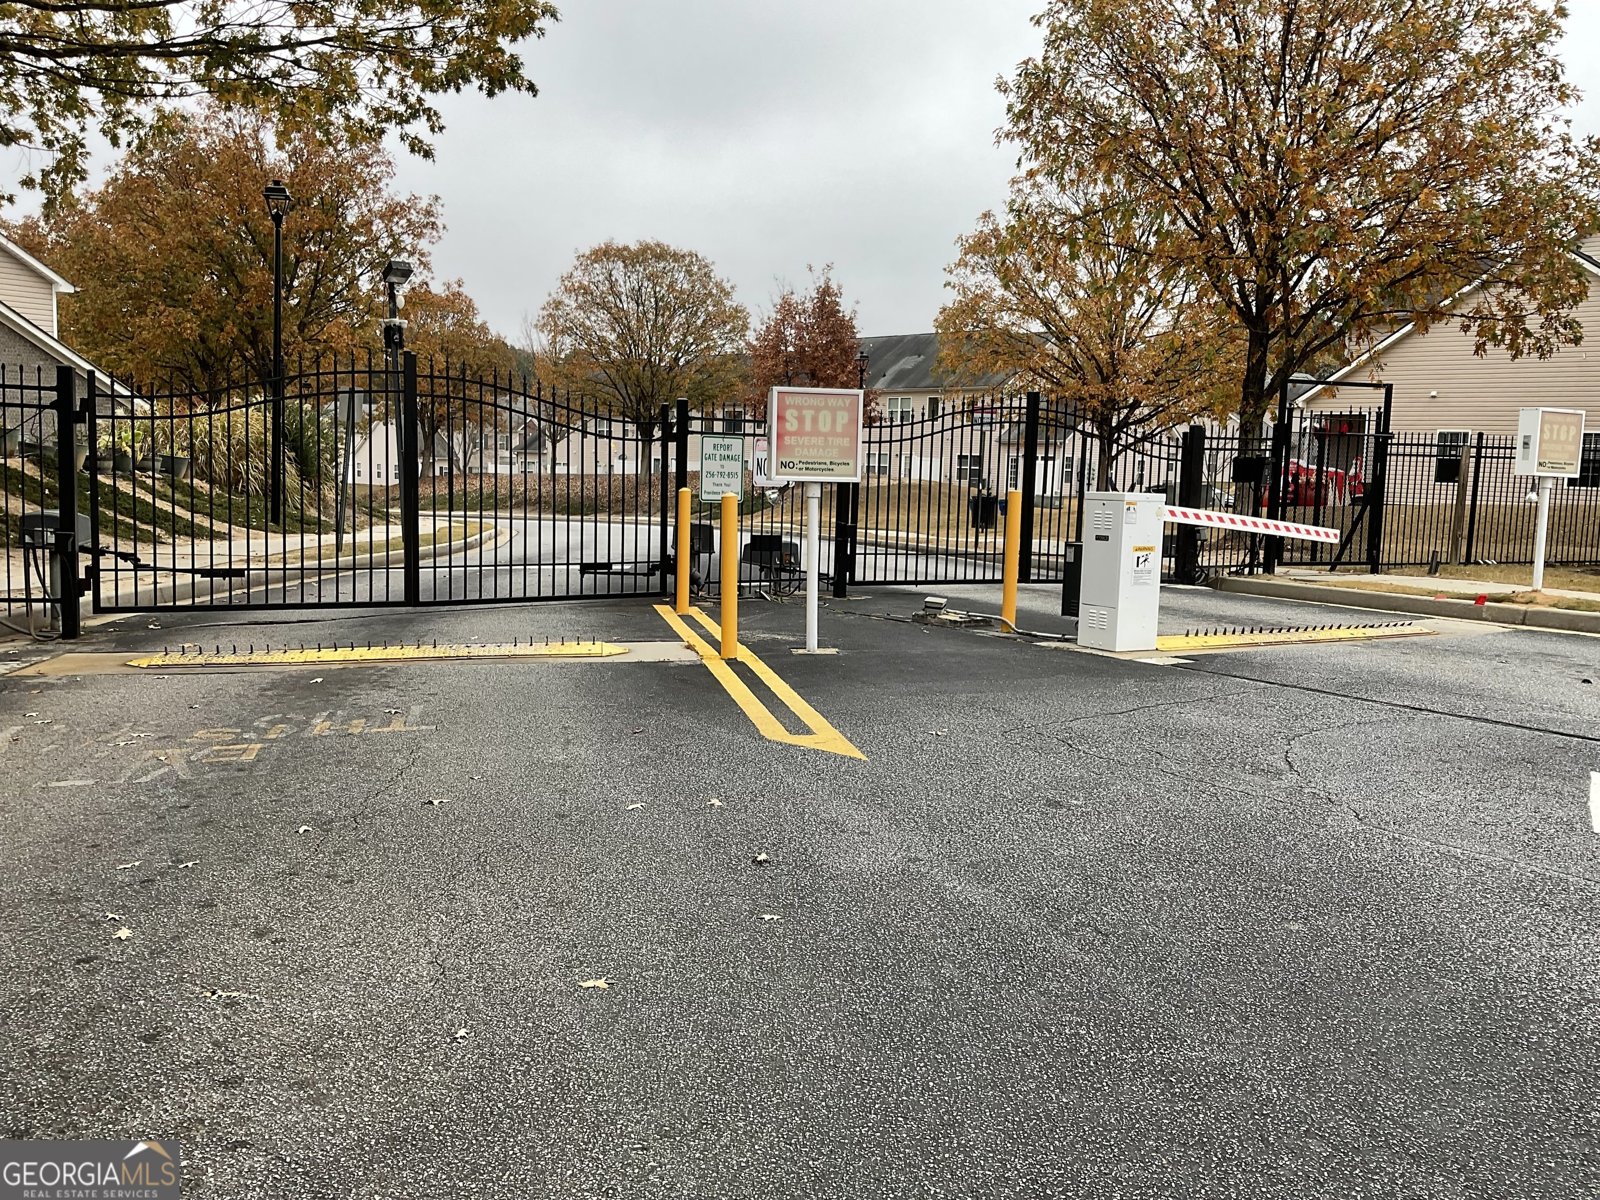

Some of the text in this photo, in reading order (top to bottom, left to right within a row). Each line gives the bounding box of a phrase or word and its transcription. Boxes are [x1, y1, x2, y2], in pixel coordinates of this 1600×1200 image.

[784, 396, 852, 408] WRONG WAY
[785, 409, 848, 432] STOP
[1544, 424, 1576, 441] STOP
[783, 436, 850, 447] SEVERE TIRE
[712, 443, 733, 452] REPORT
[794, 448, 839, 458] DAMAGE
[704, 453, 741, 463] GATE DAMAGE
